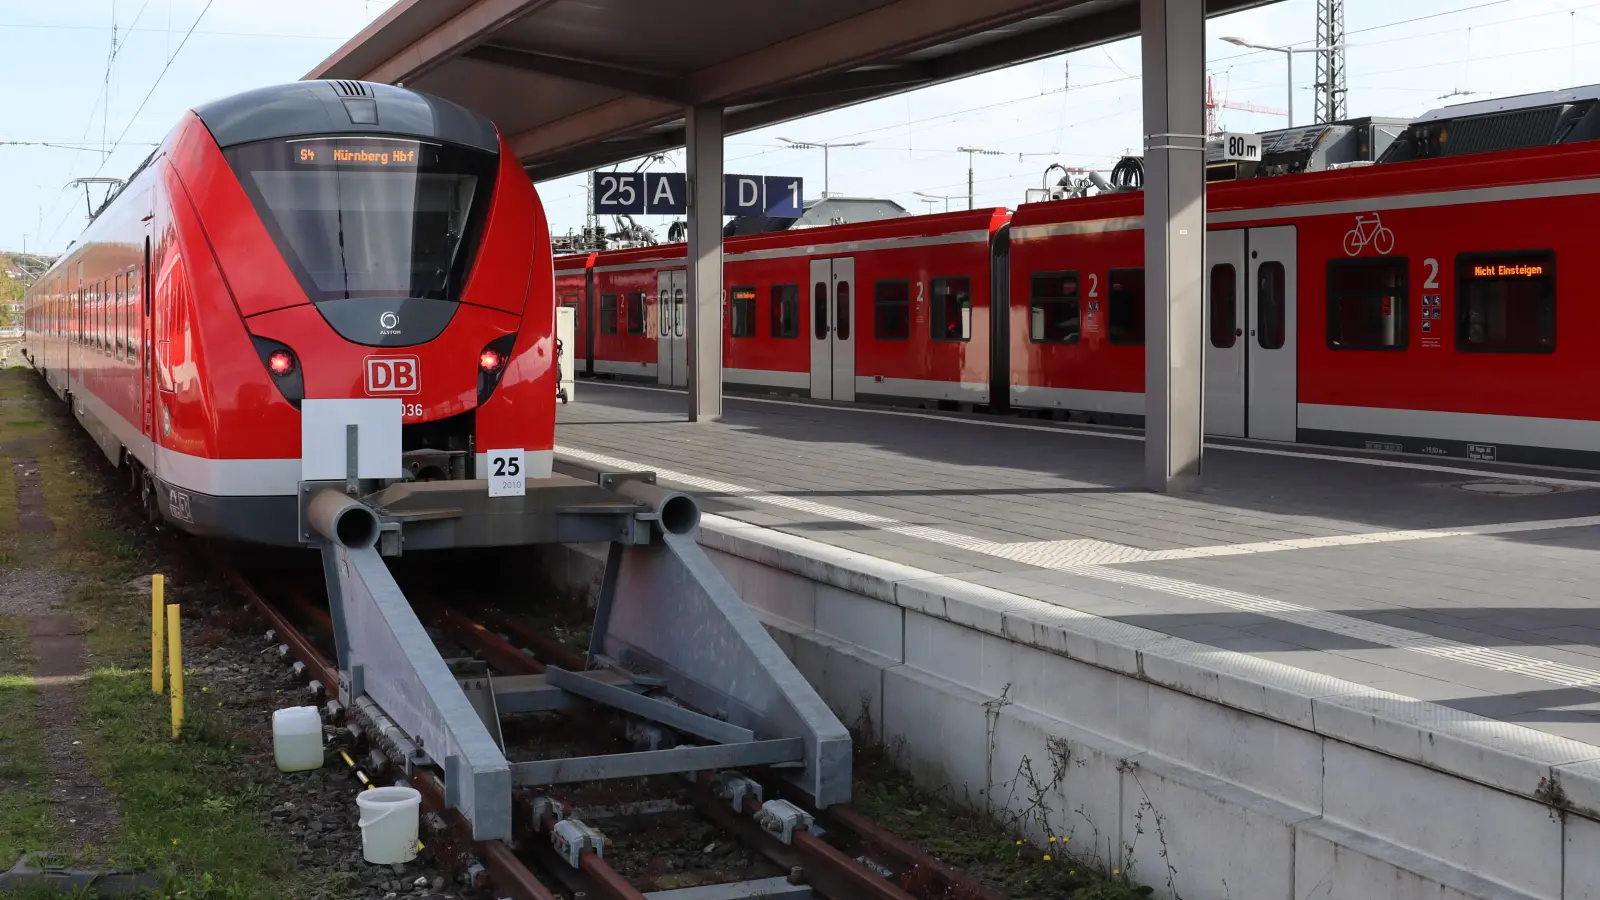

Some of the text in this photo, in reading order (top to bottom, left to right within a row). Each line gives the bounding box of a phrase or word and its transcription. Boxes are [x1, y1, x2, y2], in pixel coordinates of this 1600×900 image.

[300, 149, 414, 165] S4 Nürnberg Hbf
[1229, 136, 1256, 157] 80 m
[600, 176, 675, 206] 25 A
[738, 178, 798, 209] D 1
[1423, 257, 1439, 289] 2
[1475, 265, 1542, 277] Nicht Einsteigen
[916, 281, 924, 302] 2
[1088, 273, 1098, 297] 2
[371, 361, 414, 389] DB
[493, 456, 520, 477] 25
[502, 481, 522, 489] 2010
